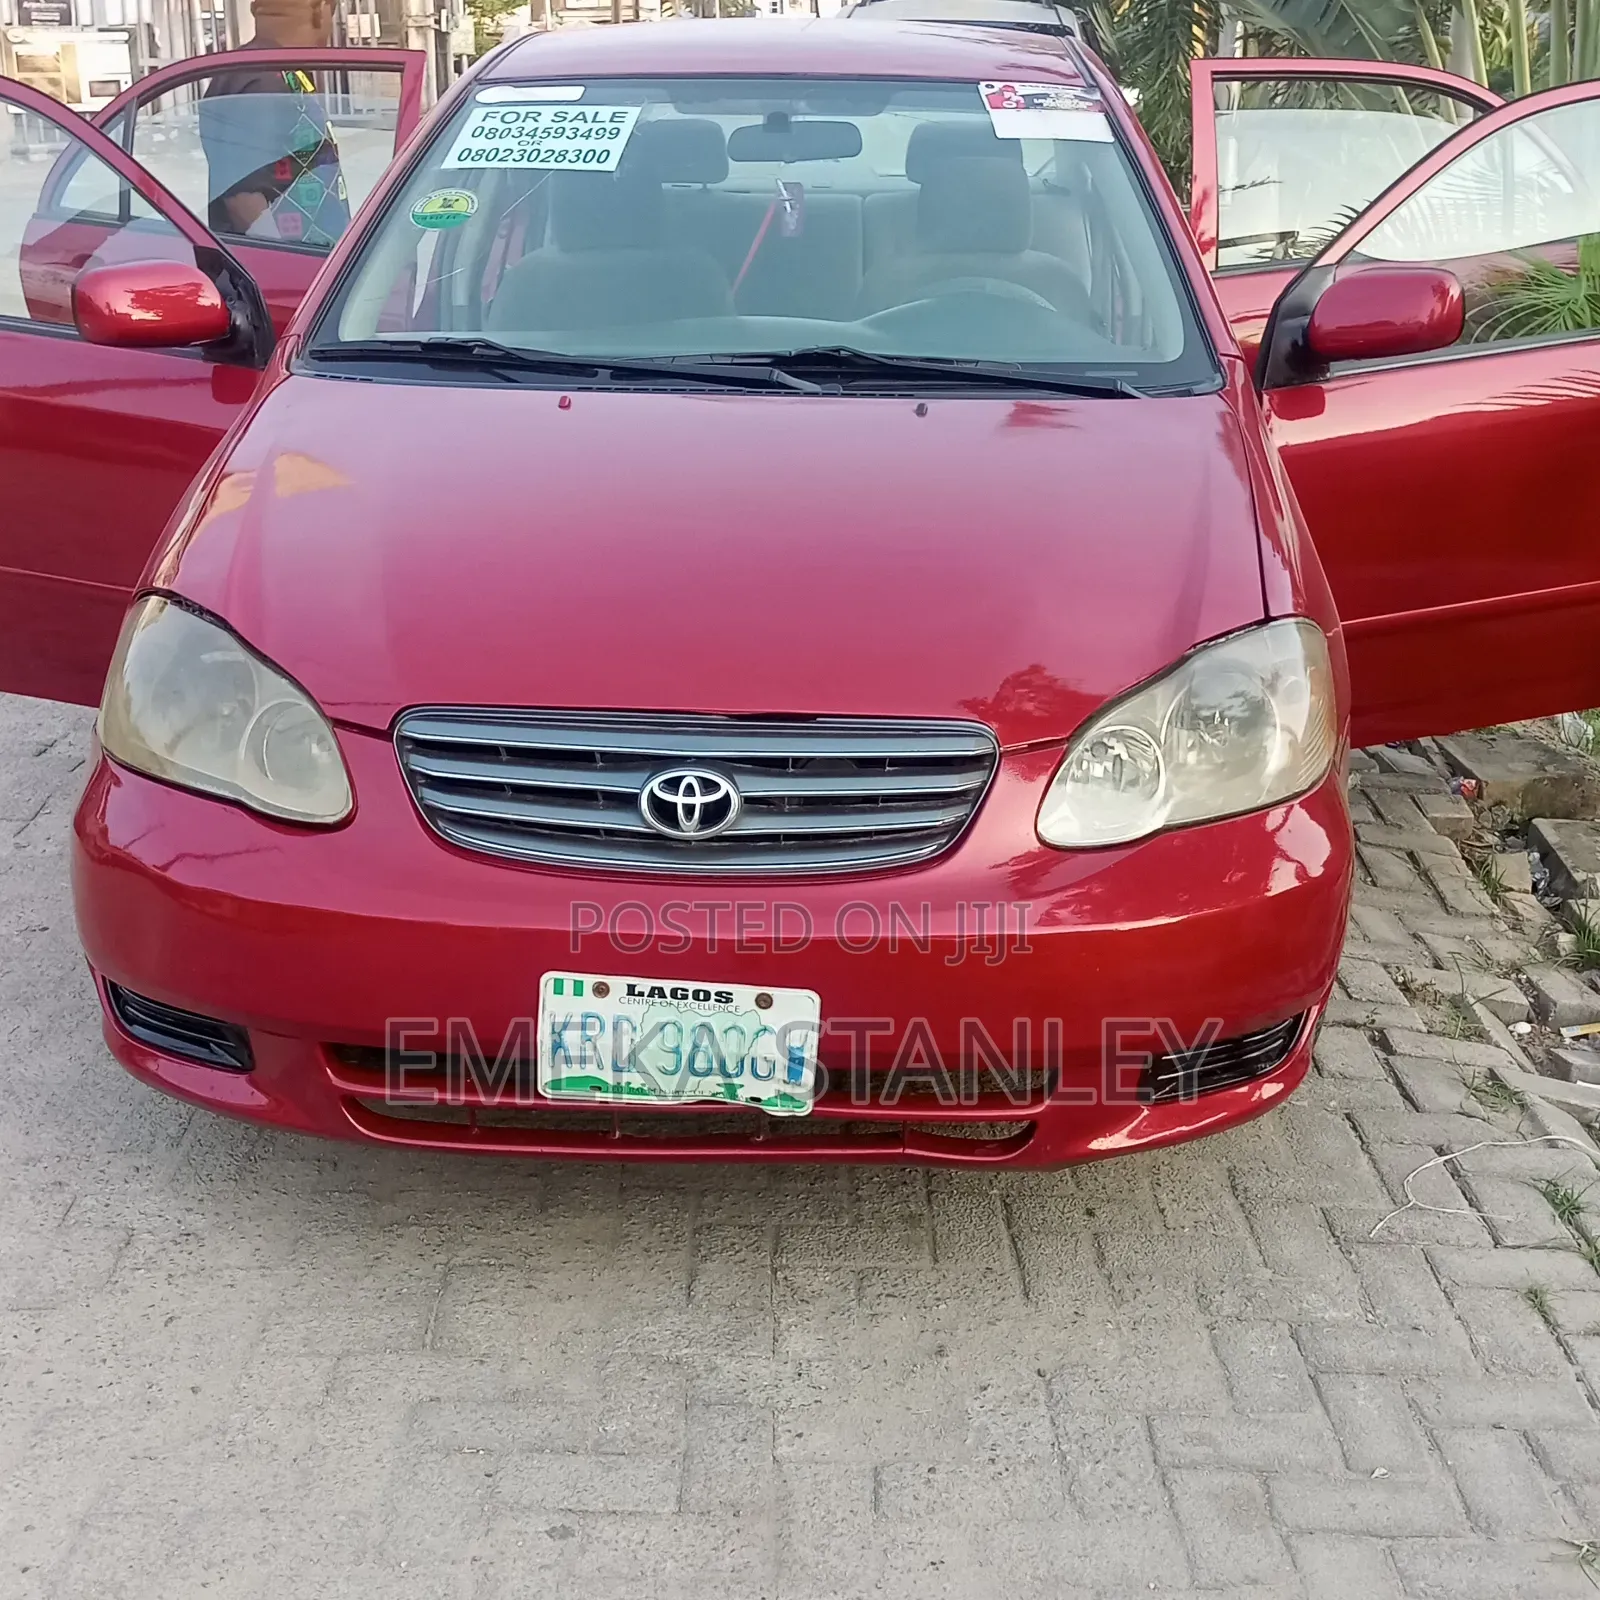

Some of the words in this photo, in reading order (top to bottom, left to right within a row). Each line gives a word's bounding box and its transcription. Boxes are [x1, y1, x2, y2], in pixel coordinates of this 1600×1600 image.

[481, 111, 542, 124] FOR
[551, 111, 629, 124] SALE
[471, 126, 621, 141] 08034593499
[457, 148, 611, 164] 08023028300
[626, 984, 734, 1004] LAGOS
[618, 996, 658, 1007] CENTRE
[661, 997, 675, 1007] OF
[676, 1000, 740, 1013] EXCELLENCE
